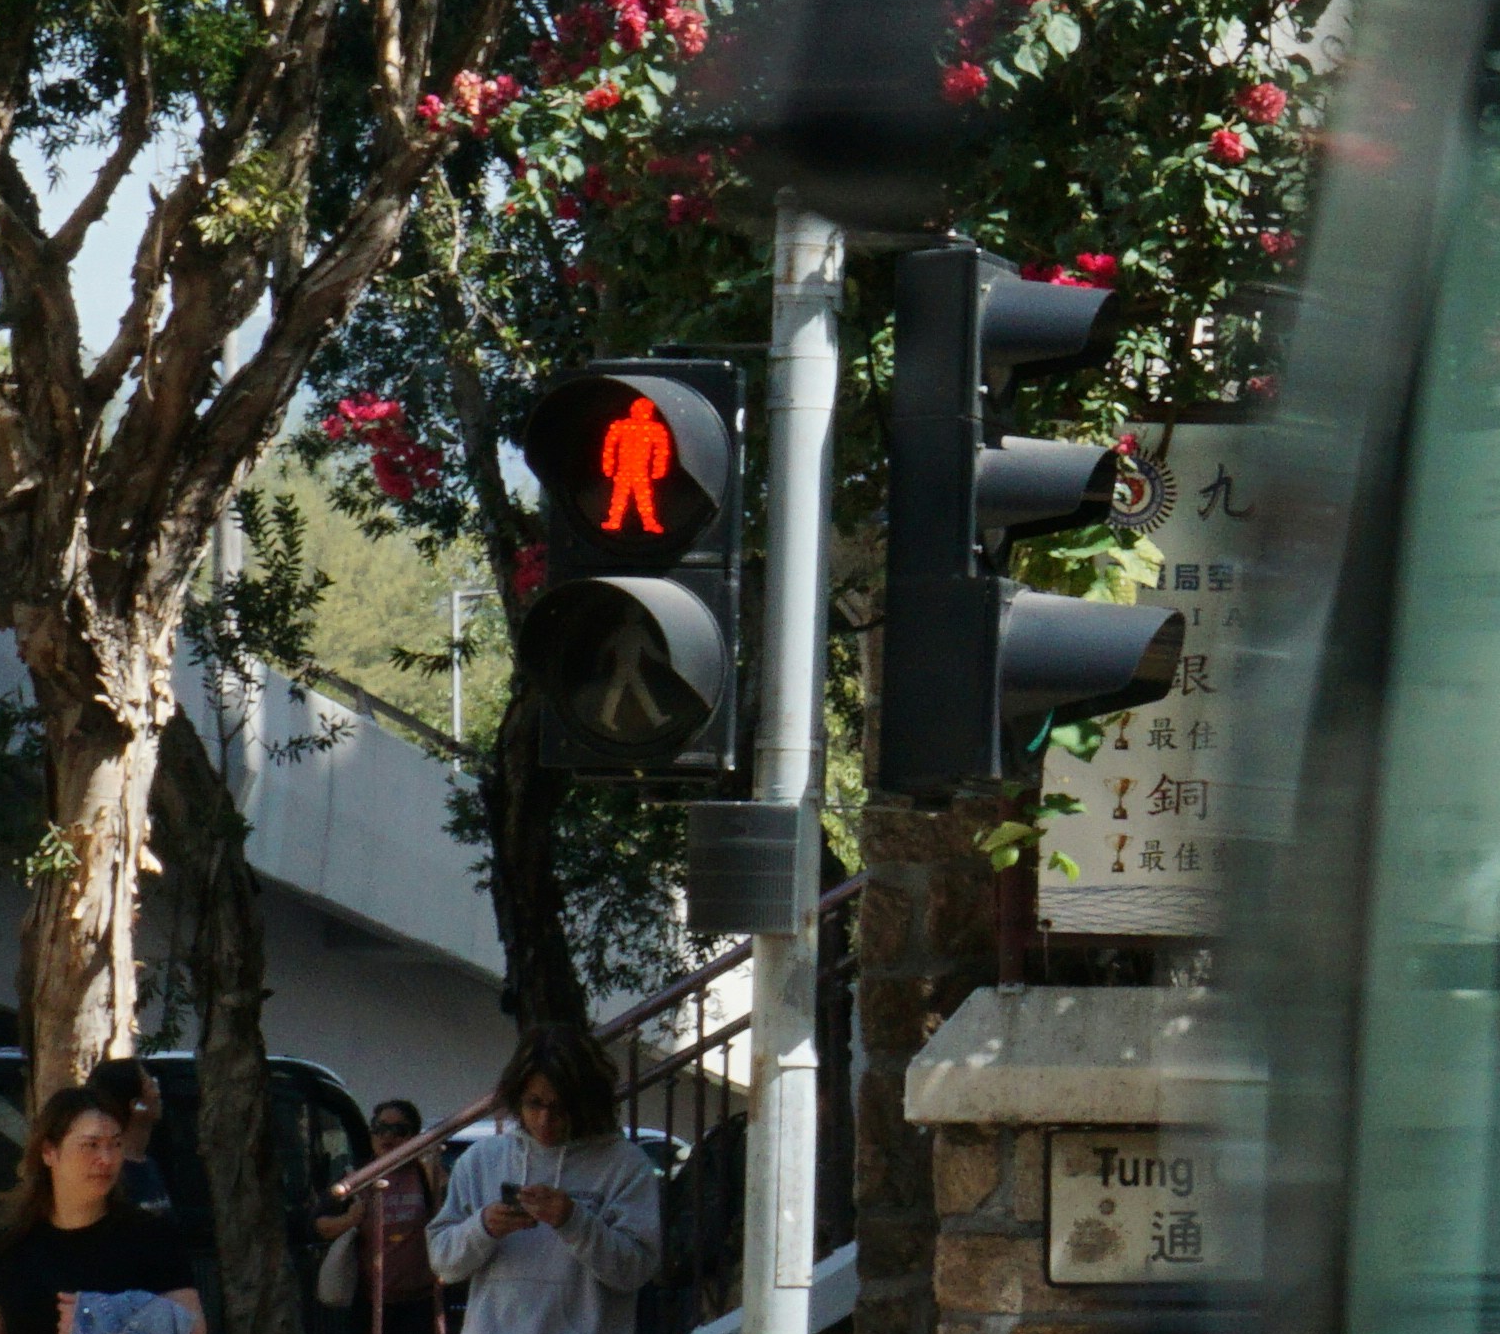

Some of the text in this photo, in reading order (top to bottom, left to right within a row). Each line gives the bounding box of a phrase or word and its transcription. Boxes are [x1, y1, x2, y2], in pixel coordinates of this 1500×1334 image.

[1197, 464, 1256, 522] 九
[1146, 773, 1209, 820] 銅
[1092, 1146, 1194, 1197] Tung
[1151, 1210, 1204, 1263] 通
